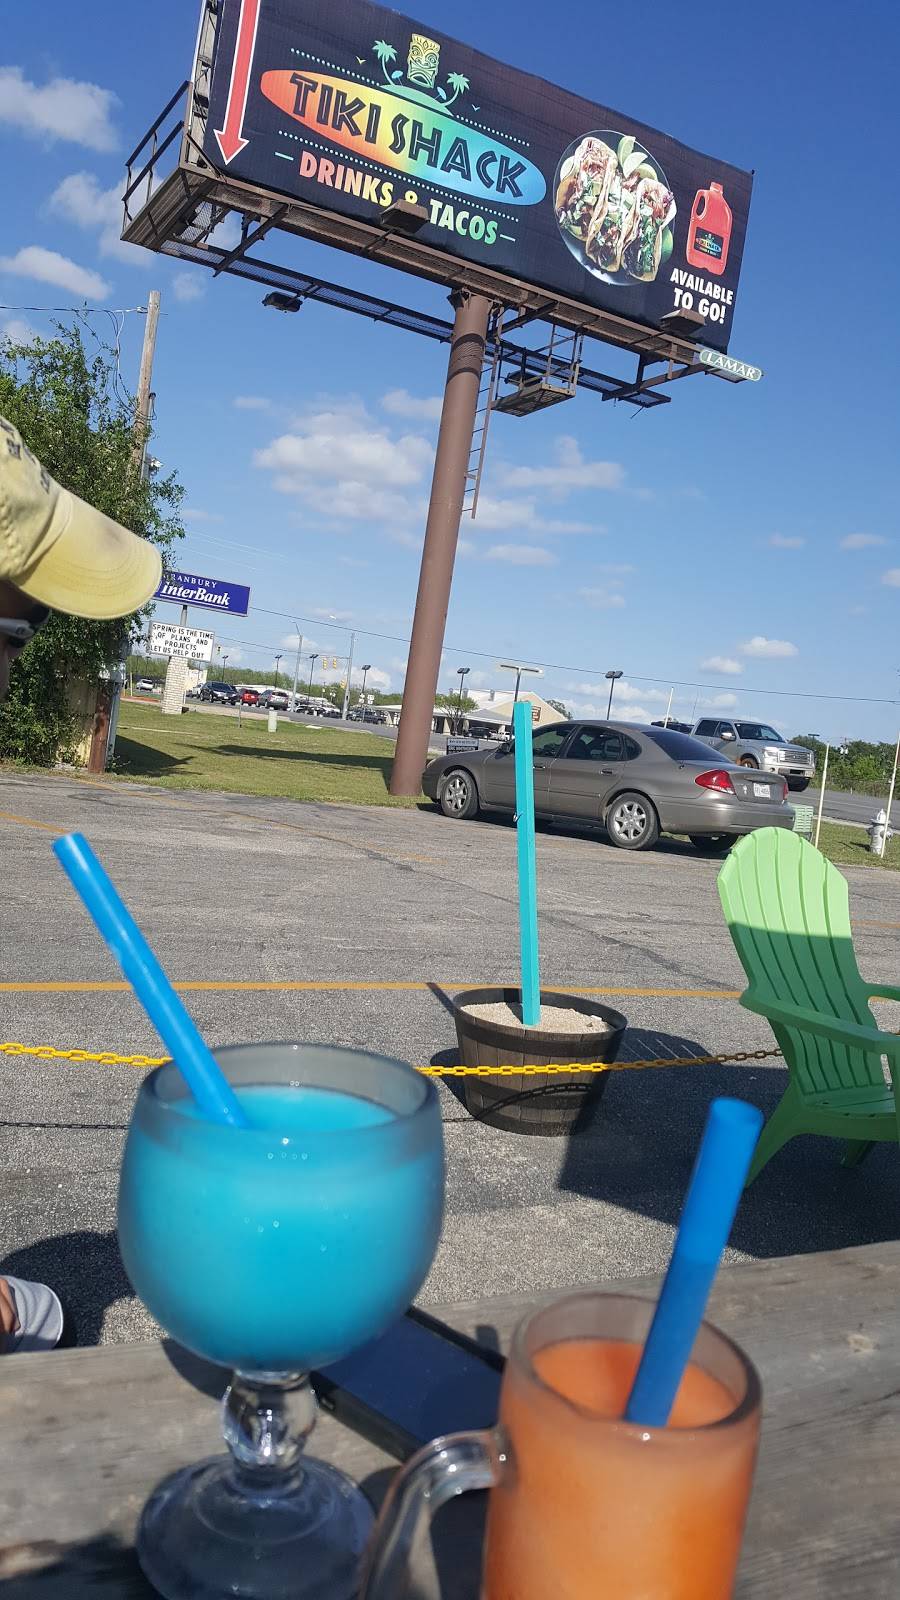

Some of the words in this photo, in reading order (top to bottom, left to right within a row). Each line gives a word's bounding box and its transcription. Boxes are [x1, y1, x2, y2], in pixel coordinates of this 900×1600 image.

[290, 72, 381, 144] TIKI
[389, 113, 527, 197] SHACK
[299, 150, 394, 208] DRINKS
[429, 198, 498, 245] TACOS
[670, 268, 734, 305] AVAILABLE
[673, 287, 694, 310] TO
[698, 298, 727, 324] GO!
[706, 352, 757, 379] LAMAR
[163, 573, 217, 589] RANBURY
[152, 624, 177, 634] SPRING
[186, 629, 198, 637] THE
[199, 631, 214, 640] TIME
[157, 631, 166, 639] OF
[170, 633, 191, 643] PLANS
[195, 638, 208, 646] AND
[162, 646, 171, 654] US
[172, 649, 189, 657] HELP
[164, 640, 197, 651] PROJECTS
